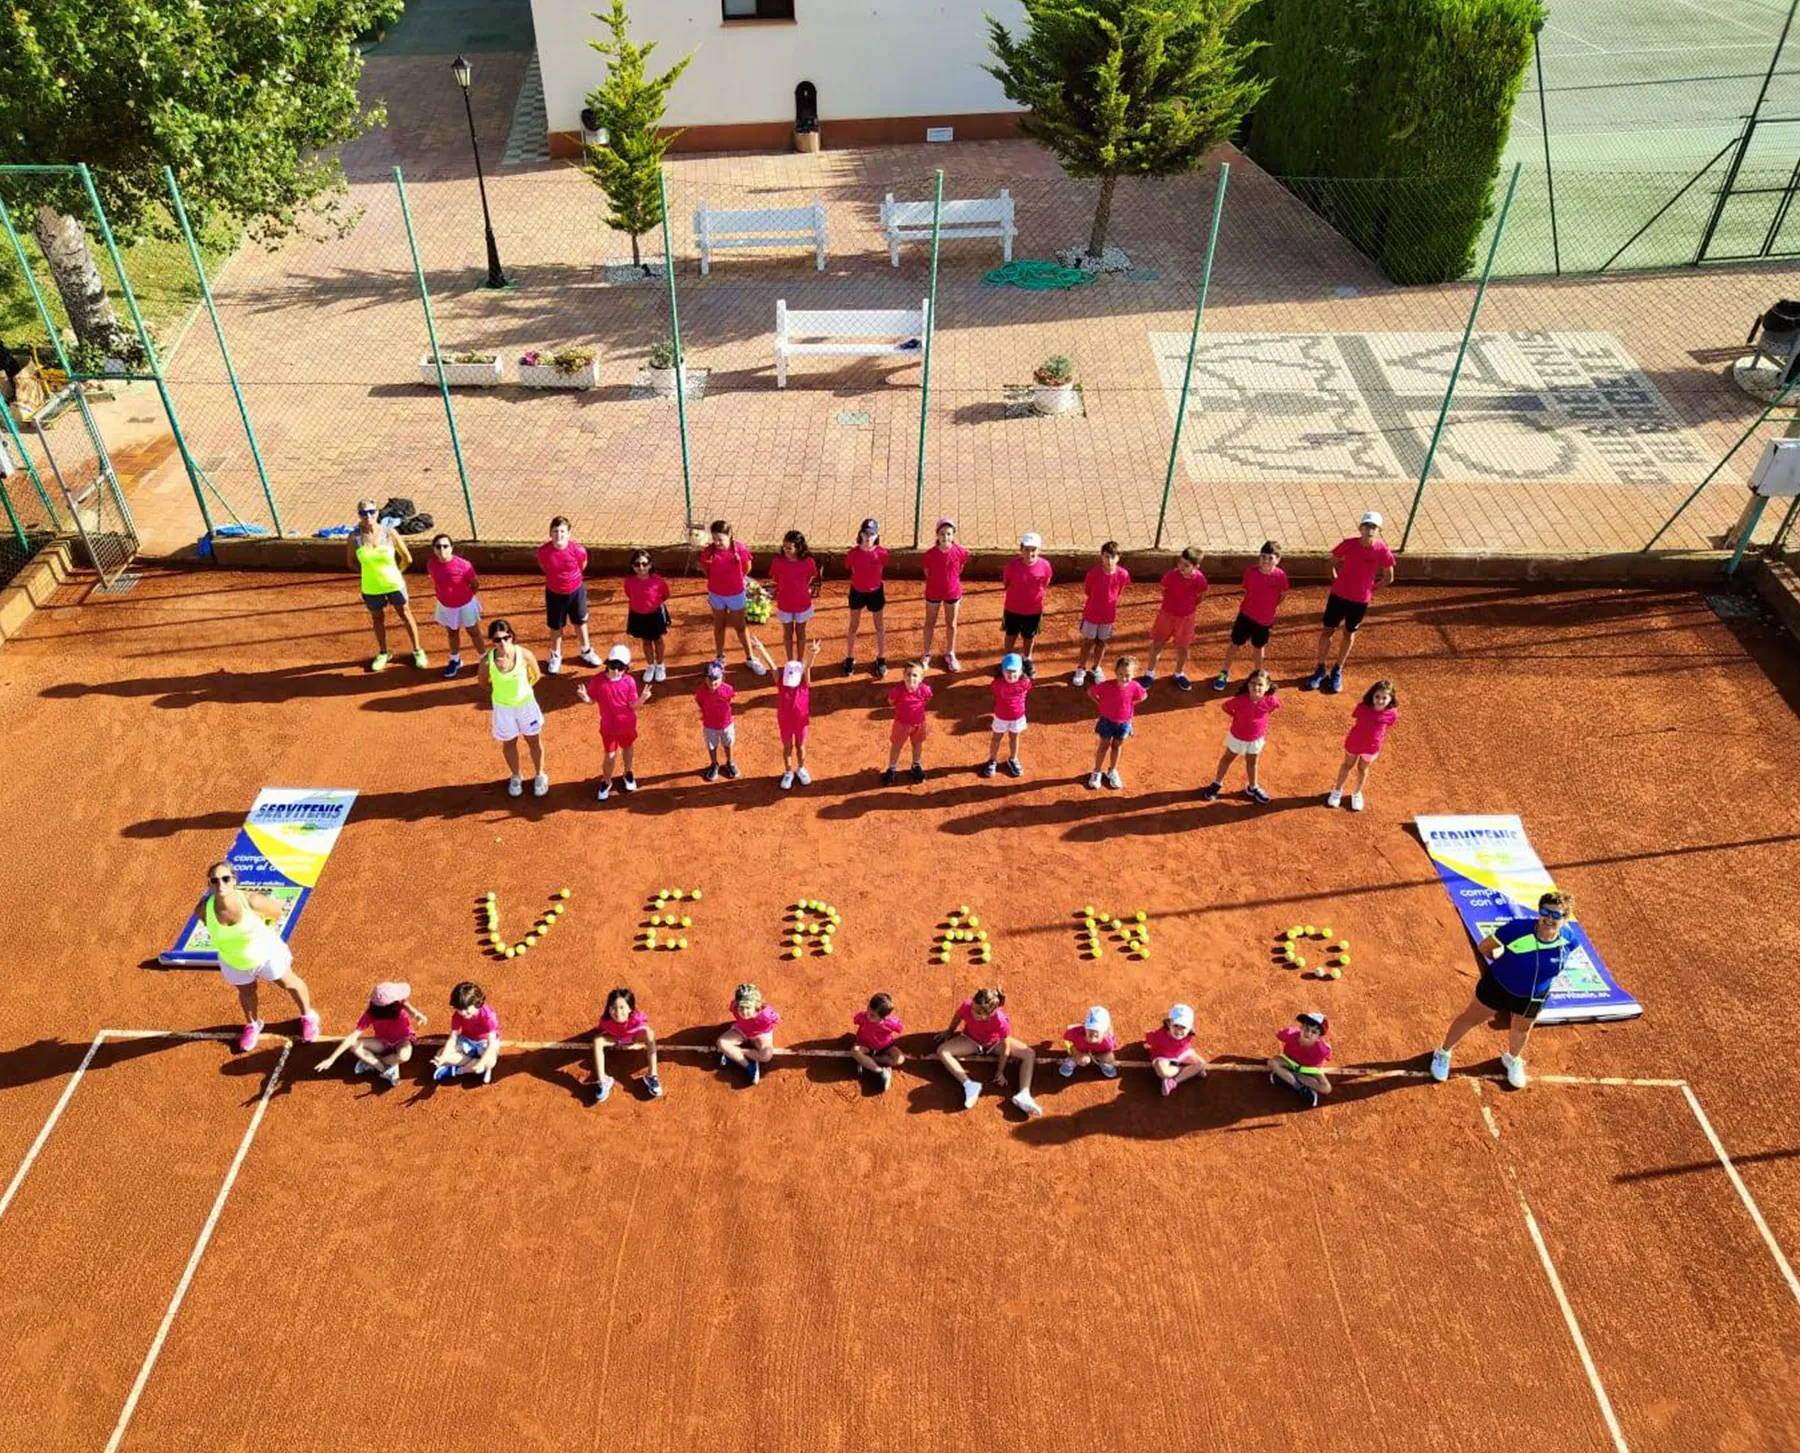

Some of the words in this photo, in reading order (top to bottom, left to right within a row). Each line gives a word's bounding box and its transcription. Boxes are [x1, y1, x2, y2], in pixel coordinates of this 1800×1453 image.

[256, 803, 344, 819] SERVITENIS
[1469, 898, 1492, 907] con
[486, 887, 1351, 980] VERANO
